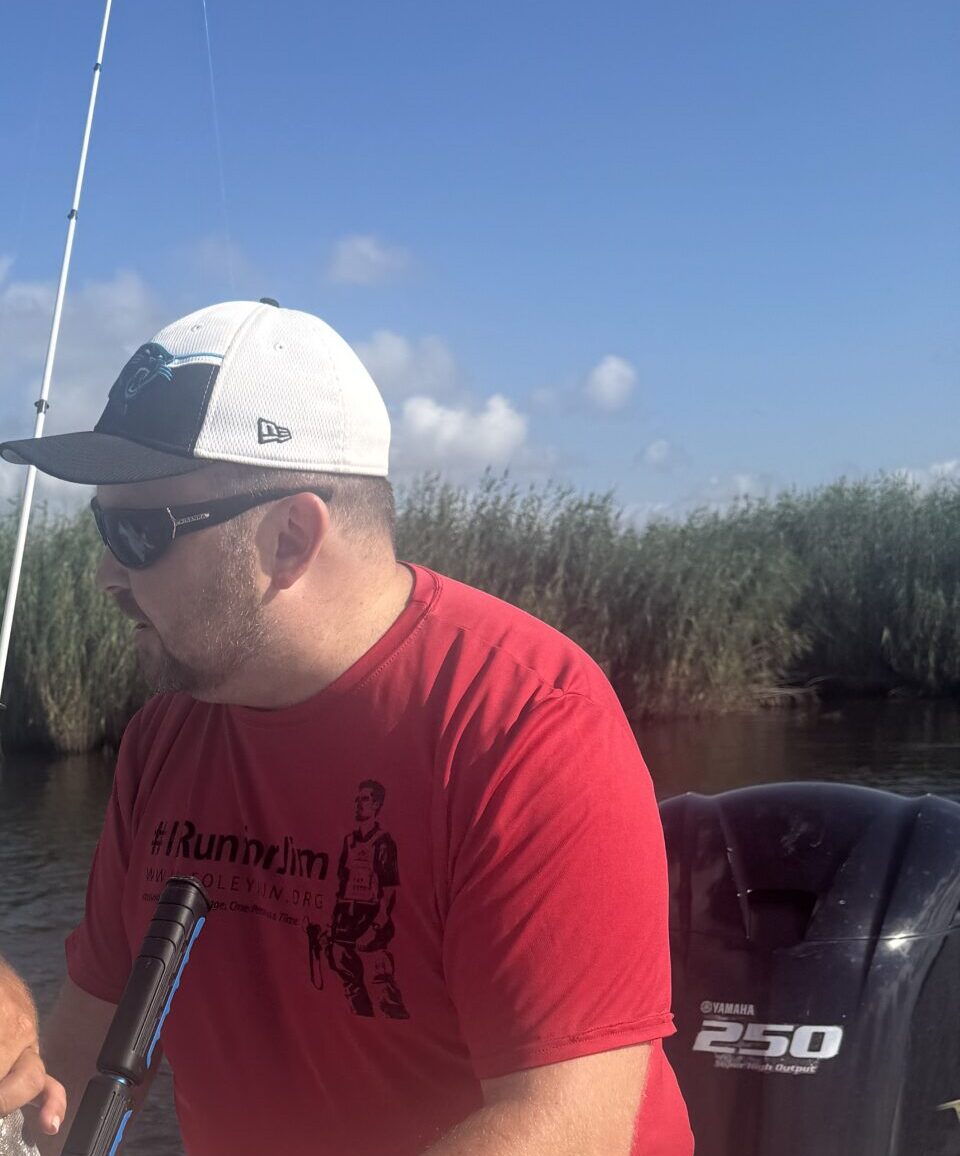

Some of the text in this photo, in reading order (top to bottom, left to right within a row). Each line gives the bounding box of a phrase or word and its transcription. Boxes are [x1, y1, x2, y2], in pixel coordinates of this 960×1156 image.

[711, 1002, 755, 1016] YAMAHA
[692, 1019, 843, 1059] 250
[774, 1063, 817, 1075] Output
